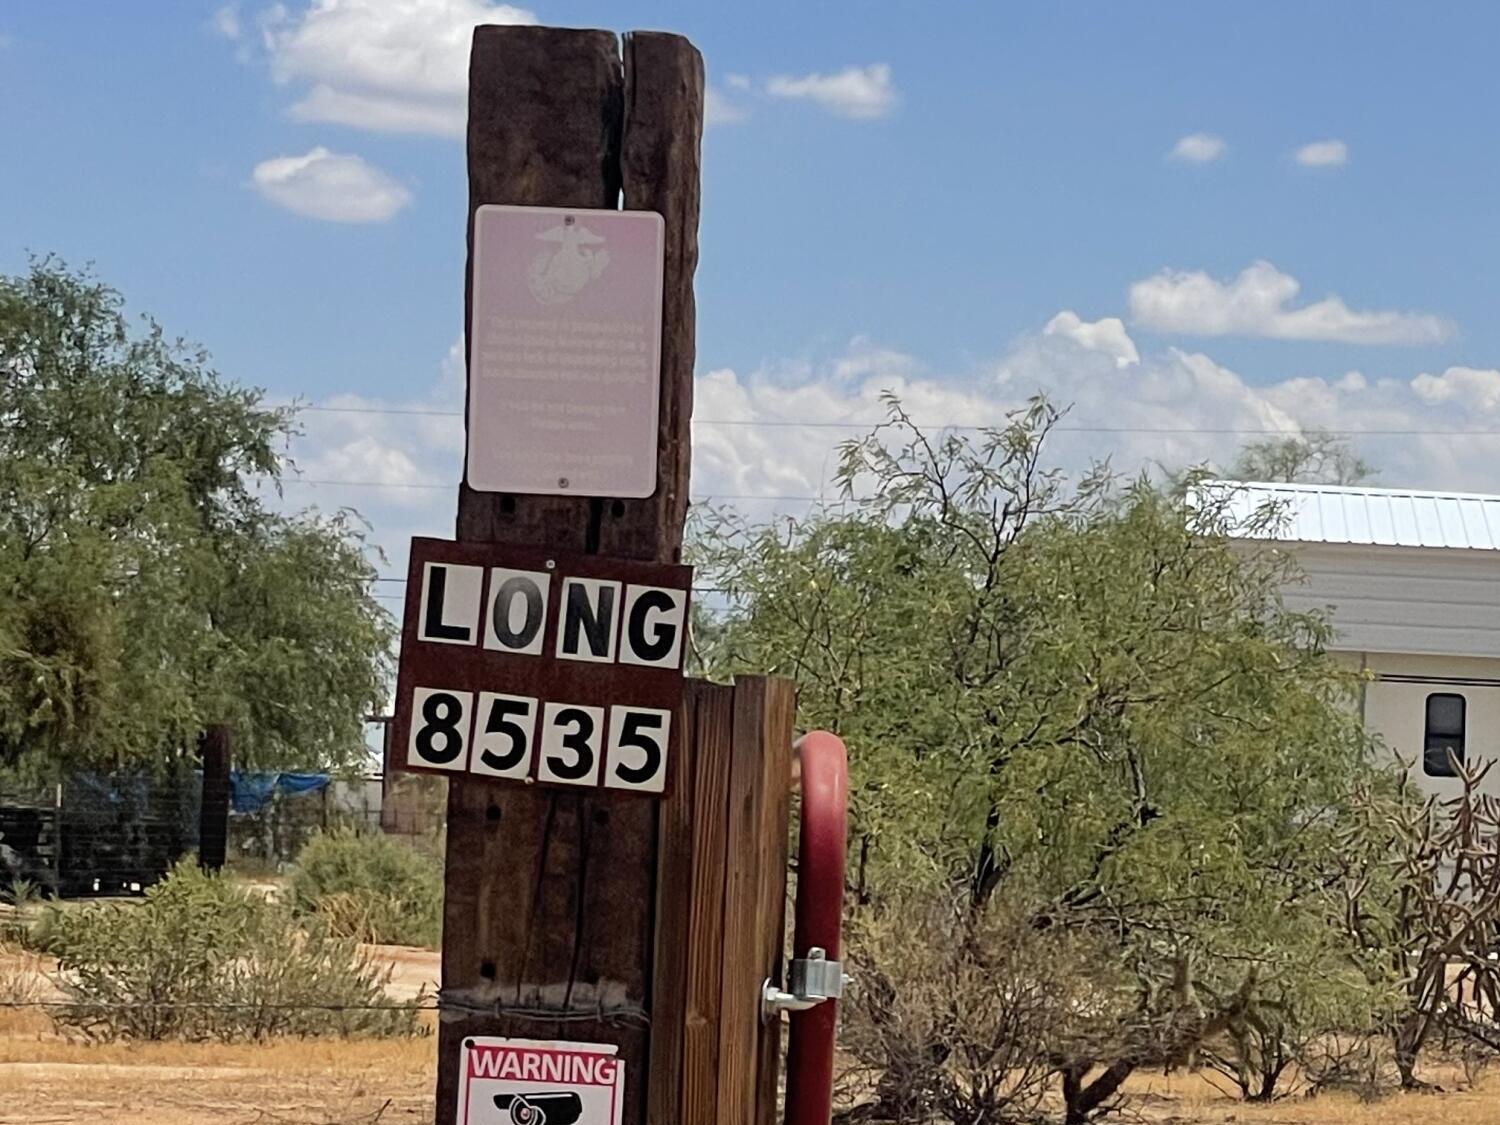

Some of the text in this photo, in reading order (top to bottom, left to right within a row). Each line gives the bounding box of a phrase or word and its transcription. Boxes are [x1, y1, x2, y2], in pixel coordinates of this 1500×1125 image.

[424, 565, 677, 661] LONG
[415, 692, 662, 784] 8535
[470, 1049, 616, 1084] WARNING
